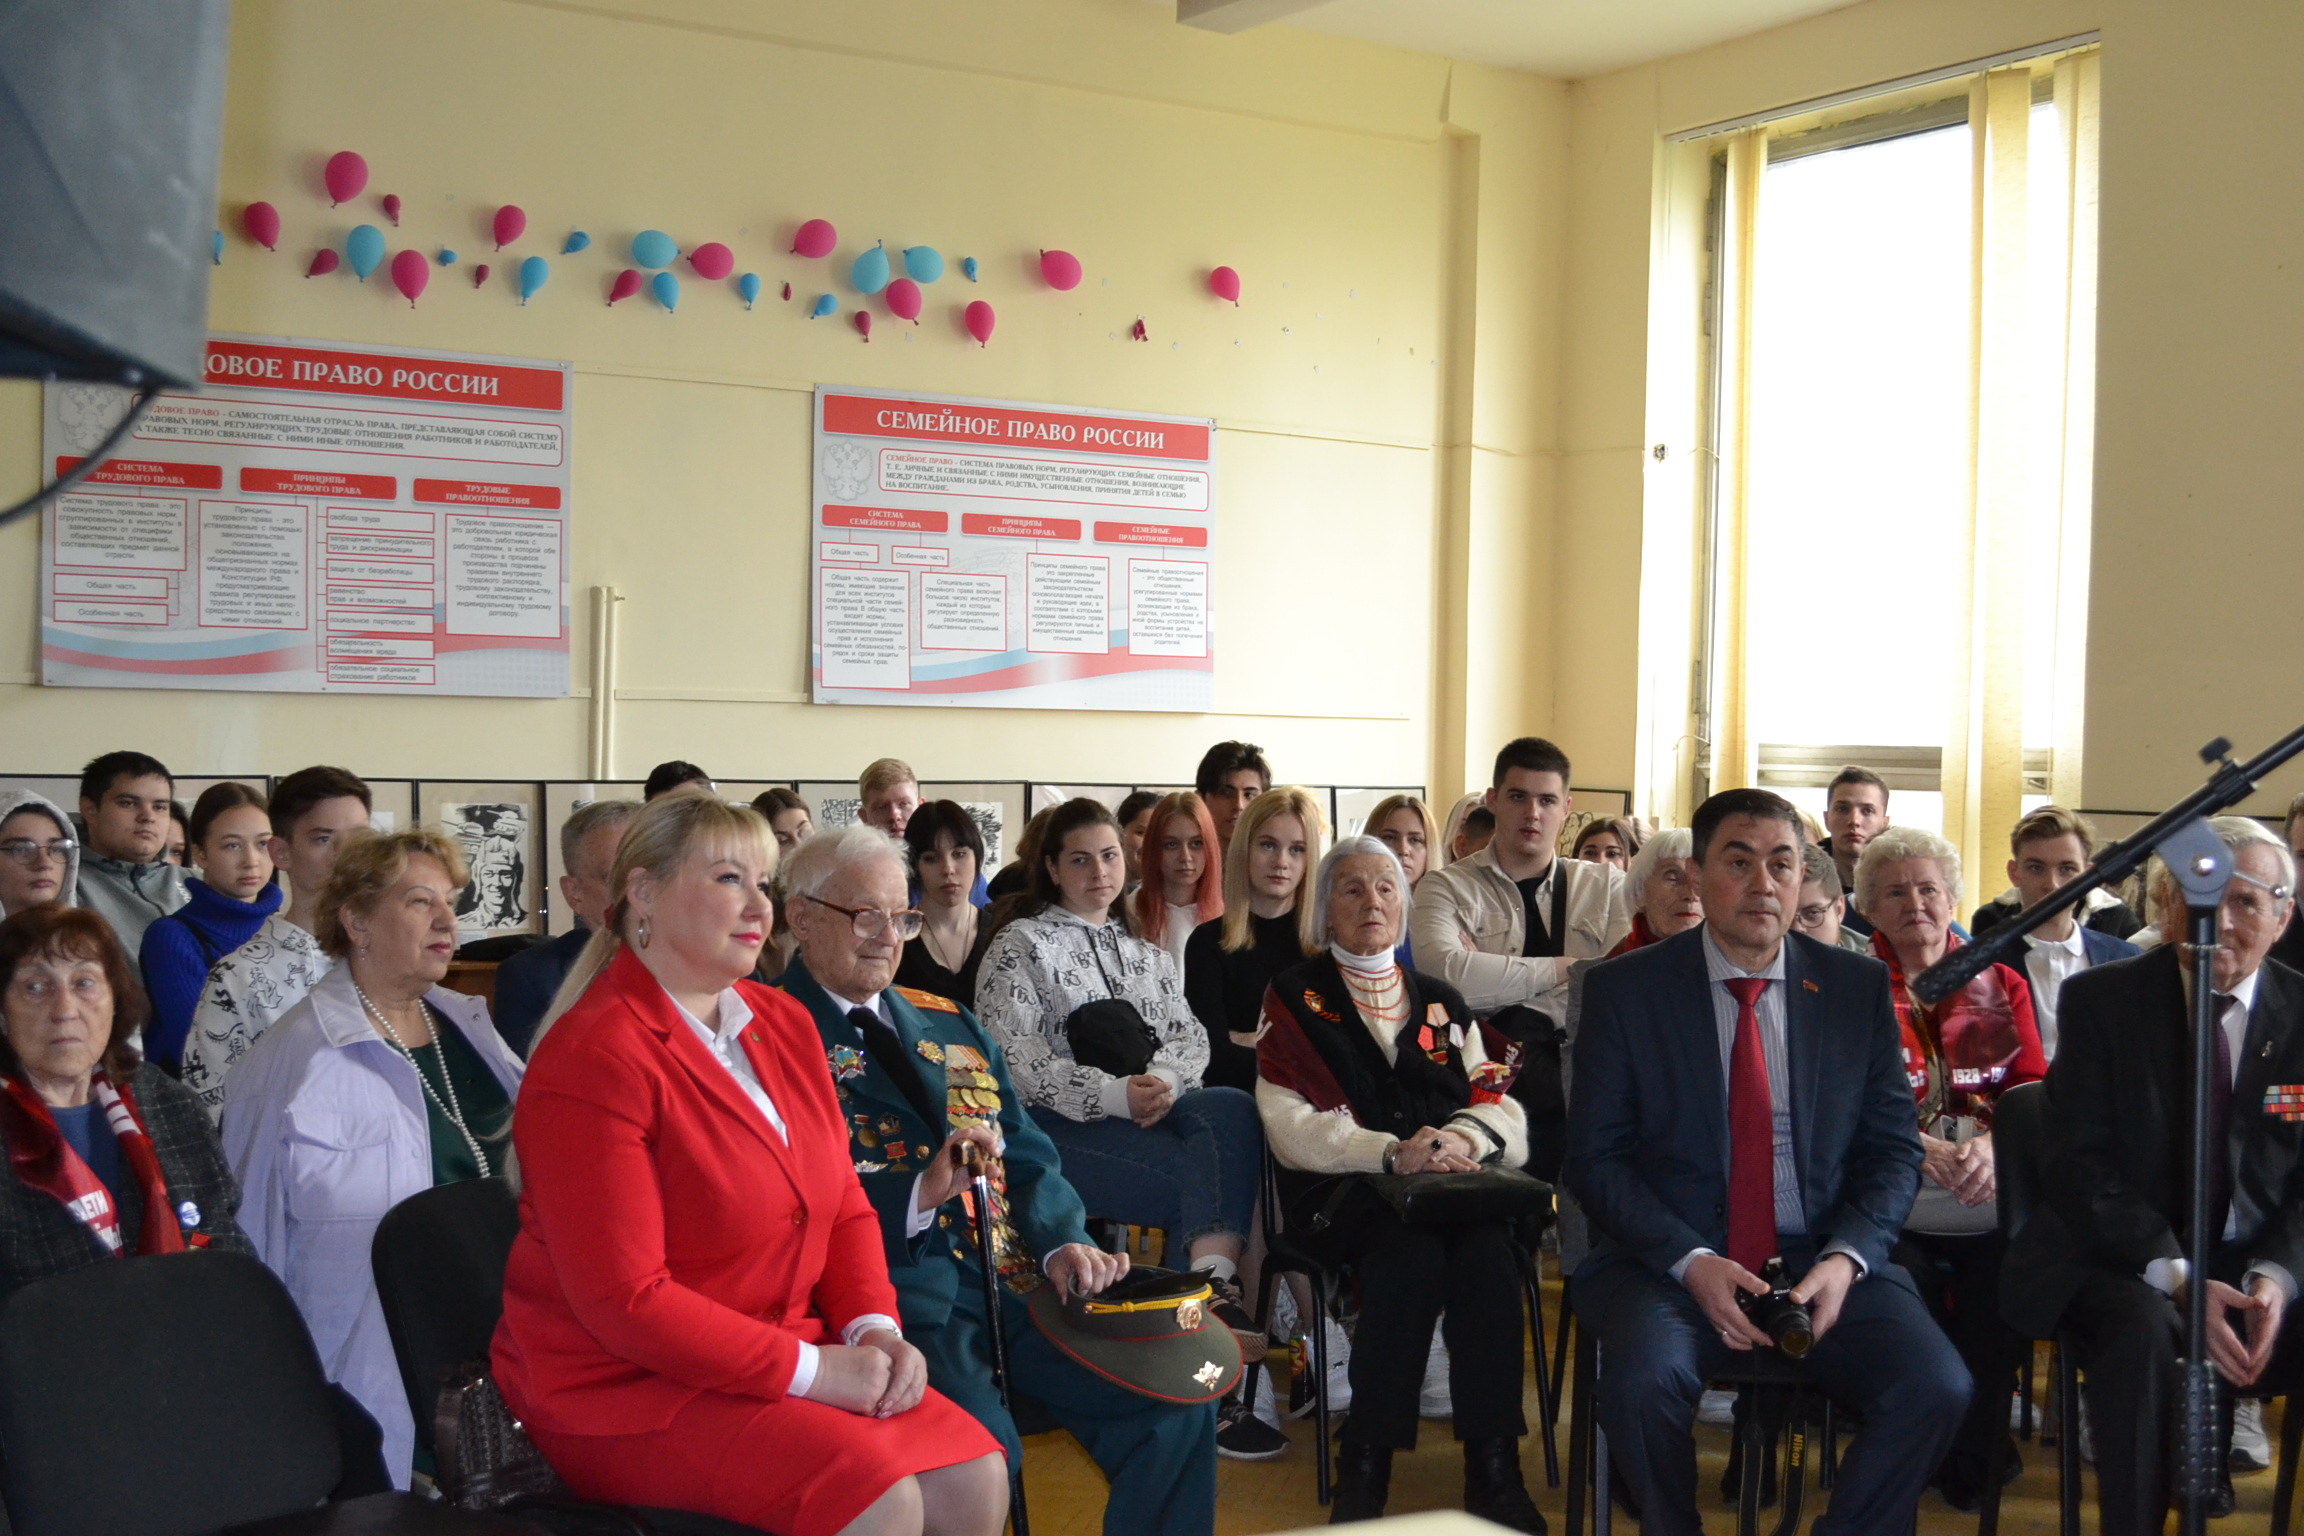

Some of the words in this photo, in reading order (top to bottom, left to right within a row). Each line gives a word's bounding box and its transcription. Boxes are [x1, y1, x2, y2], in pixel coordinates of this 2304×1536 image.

[203, 353, 282, 378] ОВОЕ
[292, 360, 382, 386] ПРАВО
[392, 369, 498, 396] РОССИИ
[151, 405, 183, 415] ДОВОЕ
[140, 414, 187, 425] РАВОВЫХ
[876, 408, 999, 436] СЕМЕЙНОЕ
[1007, 419, 1076, 442] ПРАВО
[1083, 426, 1163, 449] РОССИИ
[116, 463, 164, 473] СИСТЕМА
[95, 472, 151, 483] ТРУДОВОГО
[152, 475, 184, 484] ПРАВА
[277, 482, 330, 493] ТРУДОВОГО
[331, 485, 361, 494] ПРАВА
[867, 510, 904, 518] СИСТЕМА
[849, 516, 896, 526] СЕМЕЙНОГО
[896, 520, 921, 528] ПРАВА
[1952, 1067, 1981, 1085] 1928
[1791, 1433, 1804, 1467] Nikon
